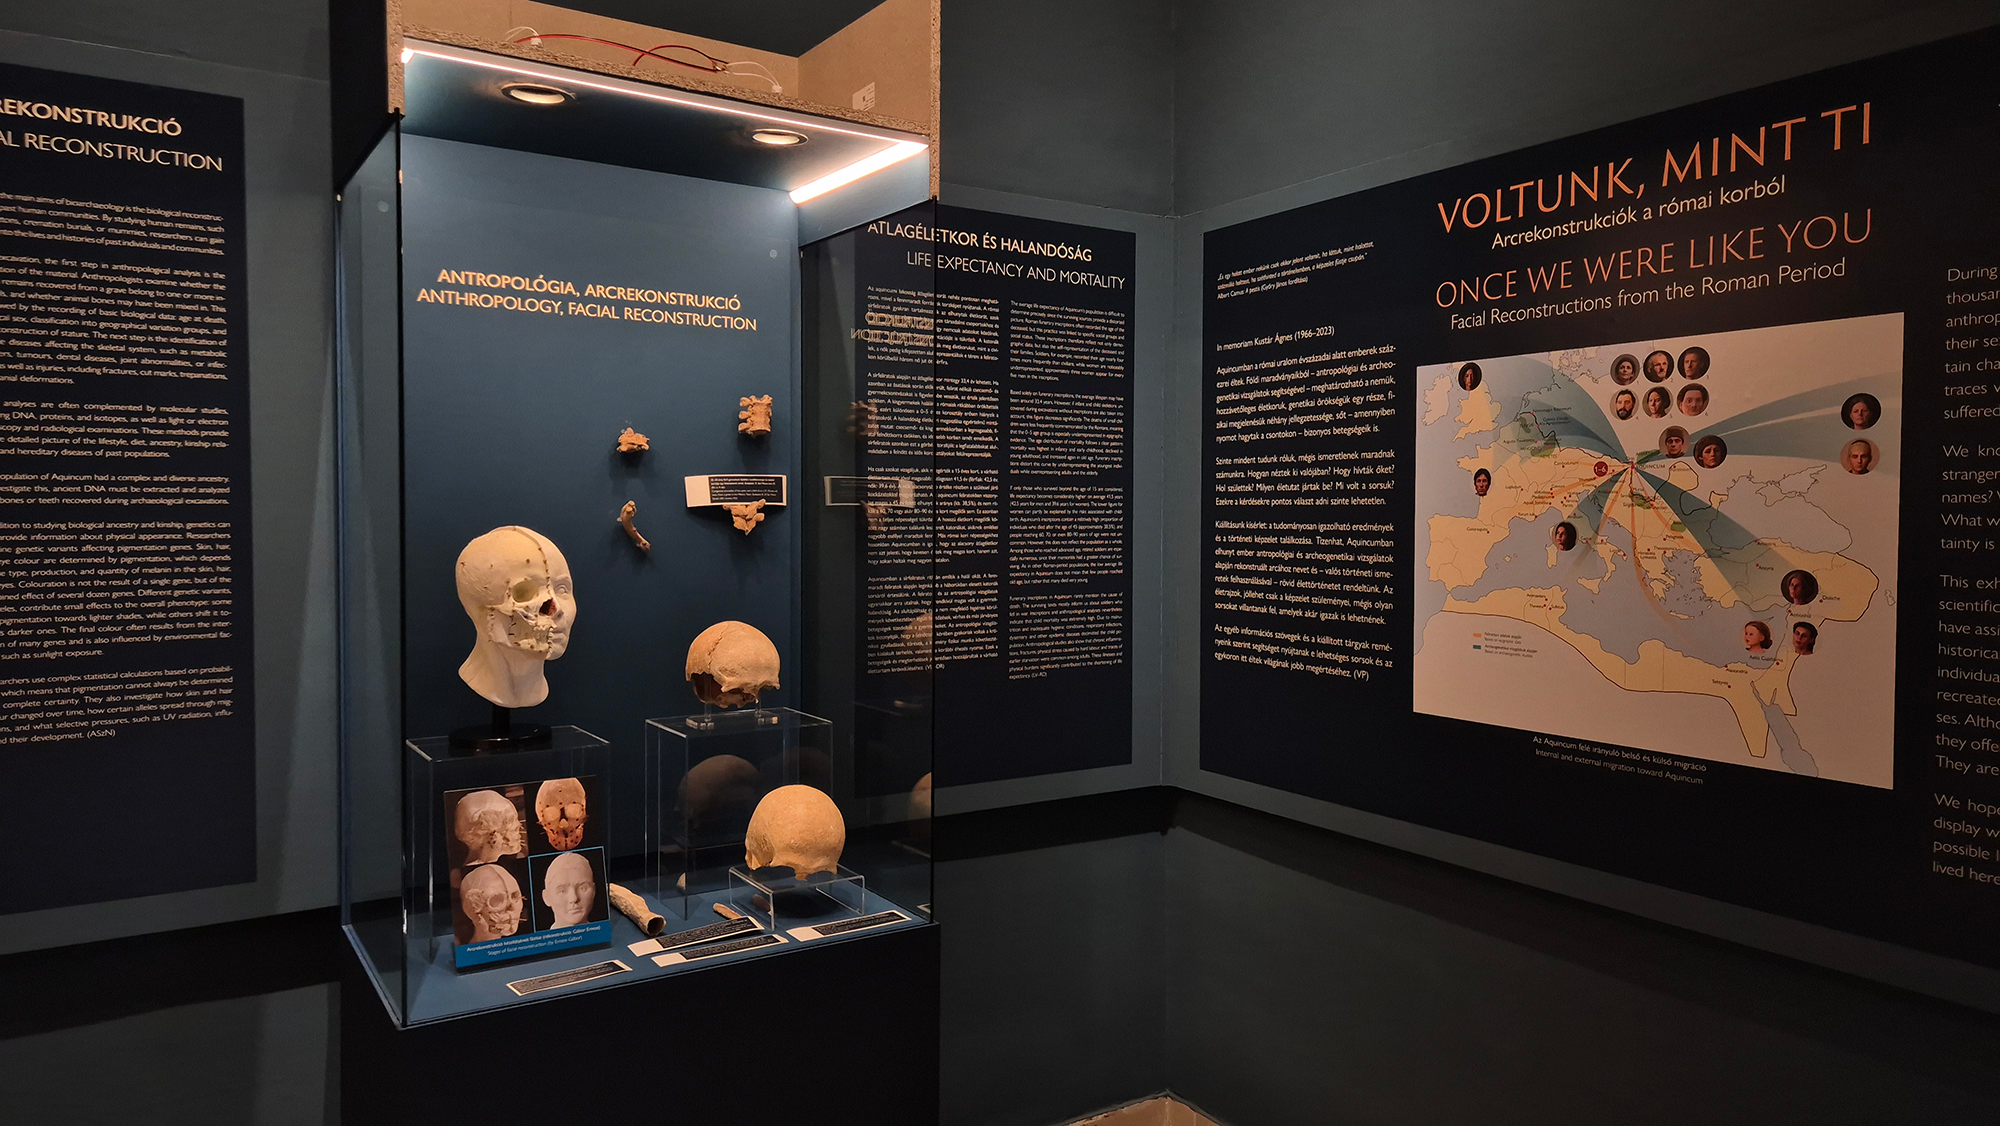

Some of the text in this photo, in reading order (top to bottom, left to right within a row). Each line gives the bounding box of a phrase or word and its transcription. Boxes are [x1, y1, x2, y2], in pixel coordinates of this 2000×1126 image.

[24, 132, 223, 171] RECONSTRUCTION
[1437, 102, 1871, 233] VOLTUNK, MINT TI
[1492, 174, 1786, 249] Arcrekonstrukciók a római korból
[982, 231, 997, 249] ÉS
[1000, 237, 1092, 261] HALANDÓSÁG
[1436, 208, 1872, 308] ONCE WE WERE LIKE YOU
[907, 251, 1125, 289] LIFE EXPECTANCY AND MORTALITY
[1948, 266, 1998, 281] During
[436, 268, 741, 310] ANTROPOLÓGIA, ARCREKONSTRUKCIÓ
[1450, 258, 1846, 330] Facial Reconstructions from the Roman Period
[416, 288, 757, 330] ANTHROPOLOGY, FACIAL RECONSTRUCTION
[1222, 340, 1254, 350] memoriam
[1253, 335, 1274, 345] Kustár
[1274, 332, 1293, 344] Ágnes
[1294, 325, 1334, 341] (1966–2023)
[1945, 336, 2000, 350] their se
[1944, 360, 1971, 373] tain
[1944, 384, 1988, 396] traces
[1215, 448, 1394, 465] Szinte mindent tudunk róluk, mégis ismeretlenek maradnak
[1942, 444, 1969, 457] We
[1941, 489, 1993, 503] names?
[1940, 513, 1983, 526] What
[1940, 537, 1995, 552] tainty is
[1939, 574, 1969, 588] This
[1938, 619, 2000, 636] have assi
[32, 650, 63, 659] sunlight
[1937, 642, 2000, 659] historica
[1353, 669, 1369, 681] (VP)
[1937, 666, 2000, 682] individua
[2, 700, 41, 709] complete
[84, 695, 103, 704] They
[123, 692, 163, 700] investigate
[1936, 713, 1960, 724] ses.
[30, 732, 84, 741] development.
[86, 728, 115, 738] (ASzN)
[1935, 733, 2000, 752] they offe
[1532, 735, 1542, 743] Az
[1543, 737, 1577, 749] Aquincum
[1578, 742, 1590, 752] felé
[1592, 747, 1620, 756] irányuló
[1621, 750, 1641, 760] belső
[1652, 755, 1672, 765] külső
[1673, 760, 1706, 771] migráció
[1535, 748, 1560, 758] Internal
[1574, 756, 1602, 766] external
[1602, 761, 1636, 772] migration
[1636, 767, 1663, 777] toward
[1664, 771, 1703, 784] Aquincum
[1935, 754, 2000, 775] They are
[1933, 792, 1961, 808] We
[1933, 816, 1984, 837] display
[1932, 841, 1990, 859] possible
[1932, 860, 1964, 877] lived
